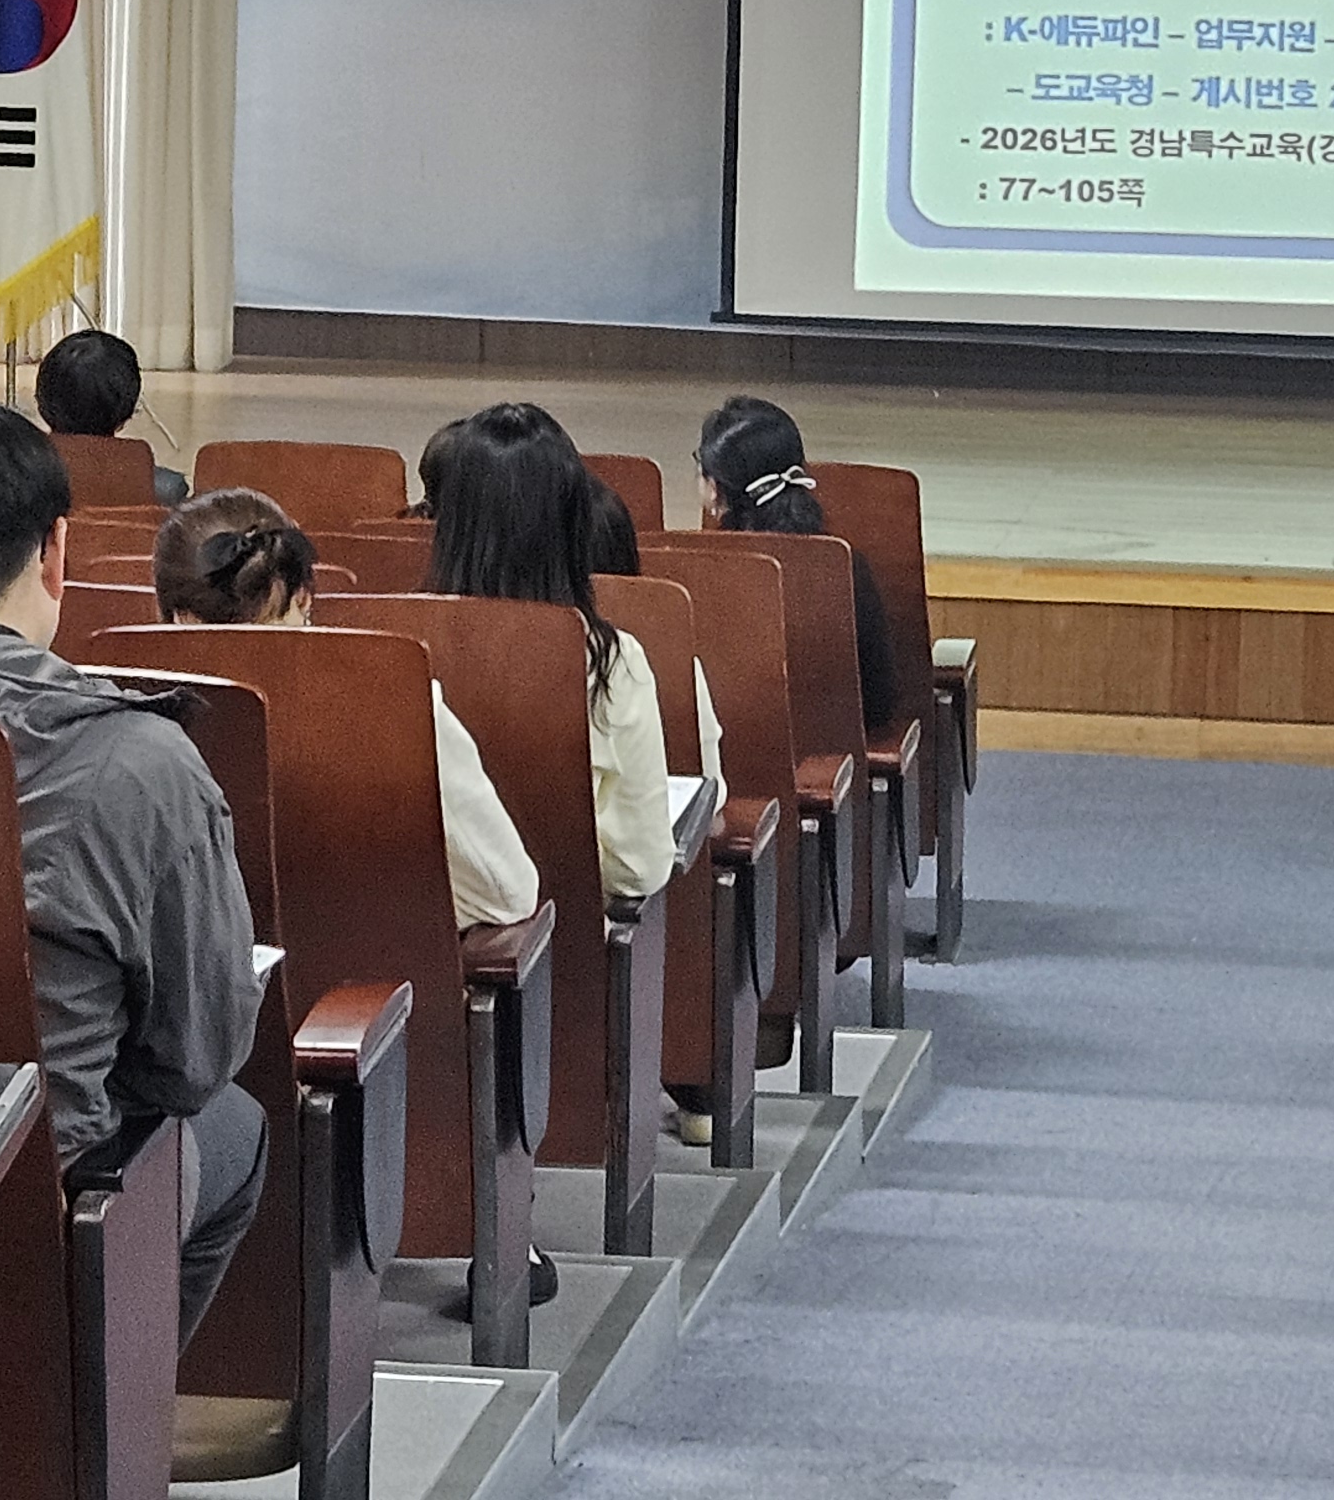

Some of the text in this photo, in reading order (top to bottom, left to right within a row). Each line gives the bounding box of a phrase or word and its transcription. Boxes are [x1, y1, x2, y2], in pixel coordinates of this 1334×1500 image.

[1003, 14, 1161, 49] K-에듀파인
[1194, 17, 1316, 54] 업무지원
[1030, 73, 1154, 107] 도교육청
[1190, 75, 1319, 111] 게시번호
[980, 126, 1118, 155] 2026년도
[998, 177, 1146, 208] 77~105쪽
